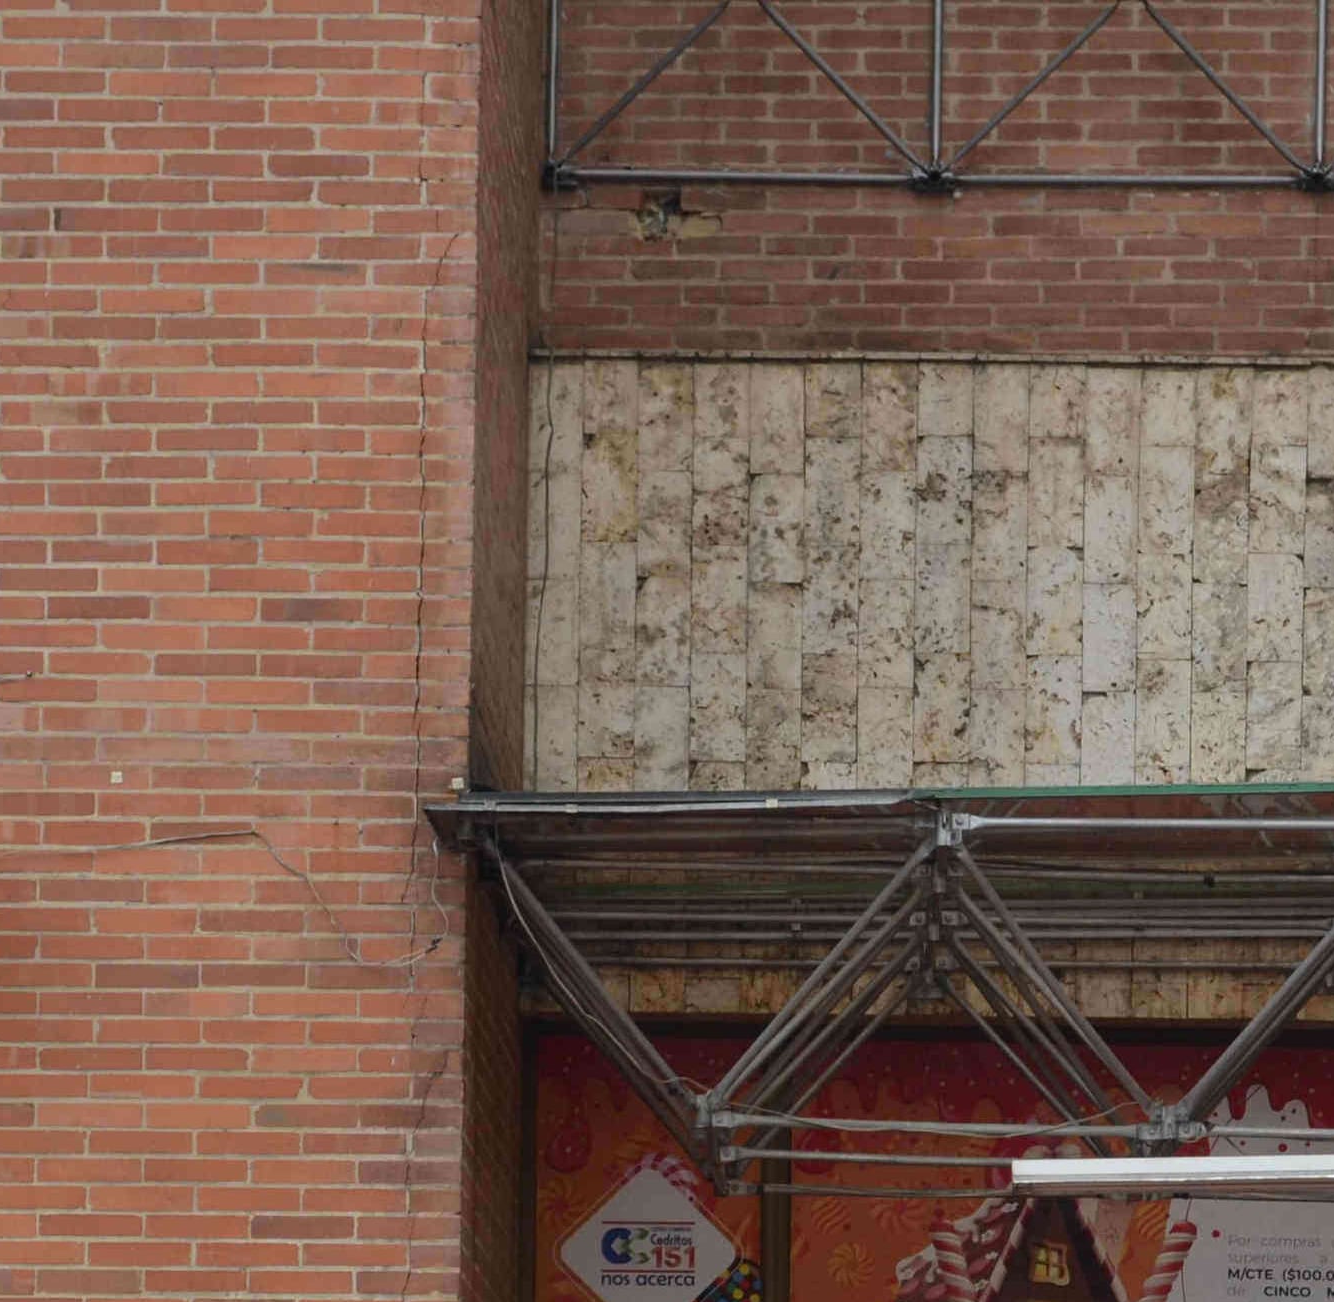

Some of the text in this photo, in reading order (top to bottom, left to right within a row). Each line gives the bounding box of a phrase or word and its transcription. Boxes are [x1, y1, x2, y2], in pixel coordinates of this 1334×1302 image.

[651, 1246, 695, 1268] 151
[602, 1274, 695, 1286] nos acerca
[1227, 1268, 1274, 1281] M/CTE
[1263, 1287, 1311, 1298] CINCO
